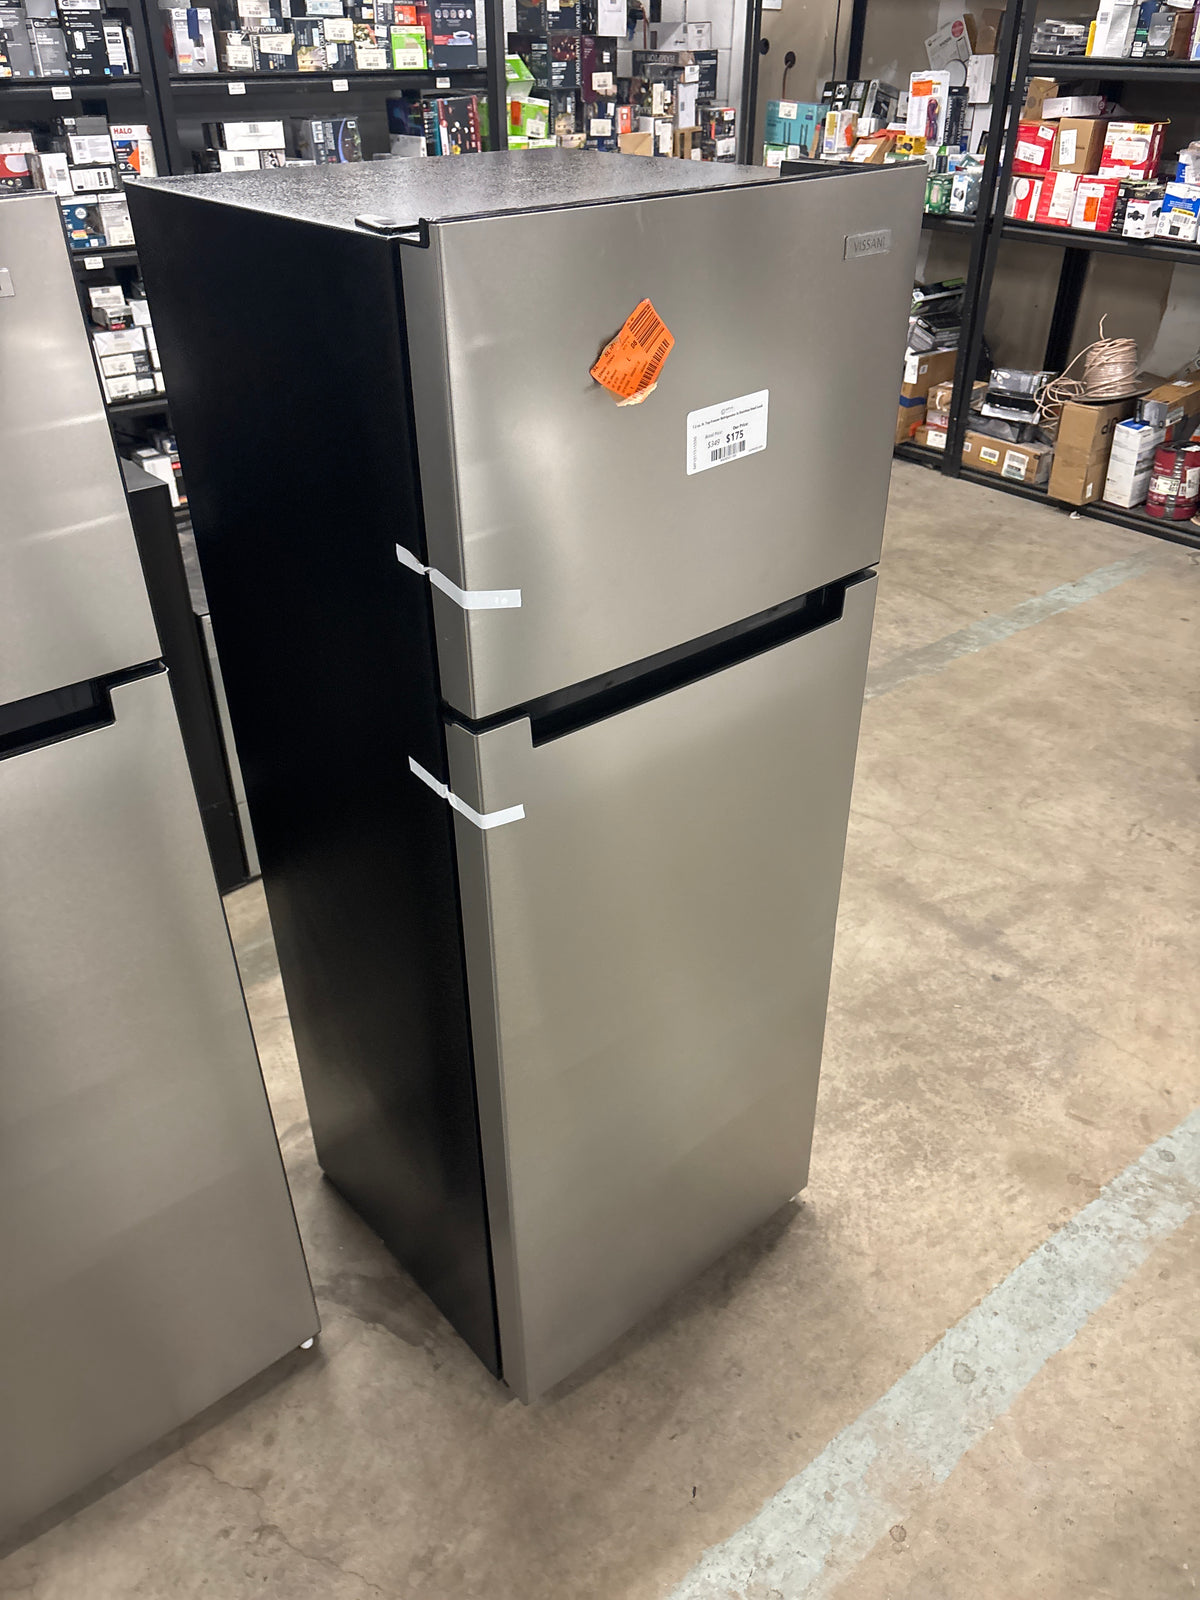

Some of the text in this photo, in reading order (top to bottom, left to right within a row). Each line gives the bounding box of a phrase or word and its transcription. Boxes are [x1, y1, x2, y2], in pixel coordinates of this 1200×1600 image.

[377, 7, 385, 21] BAY
[317, 20, 325, 34] BAY
[854, 236, 886, 253] VISSANI
[707, 438, 720, 449] $349
[726, 430, 744, 443] $175
